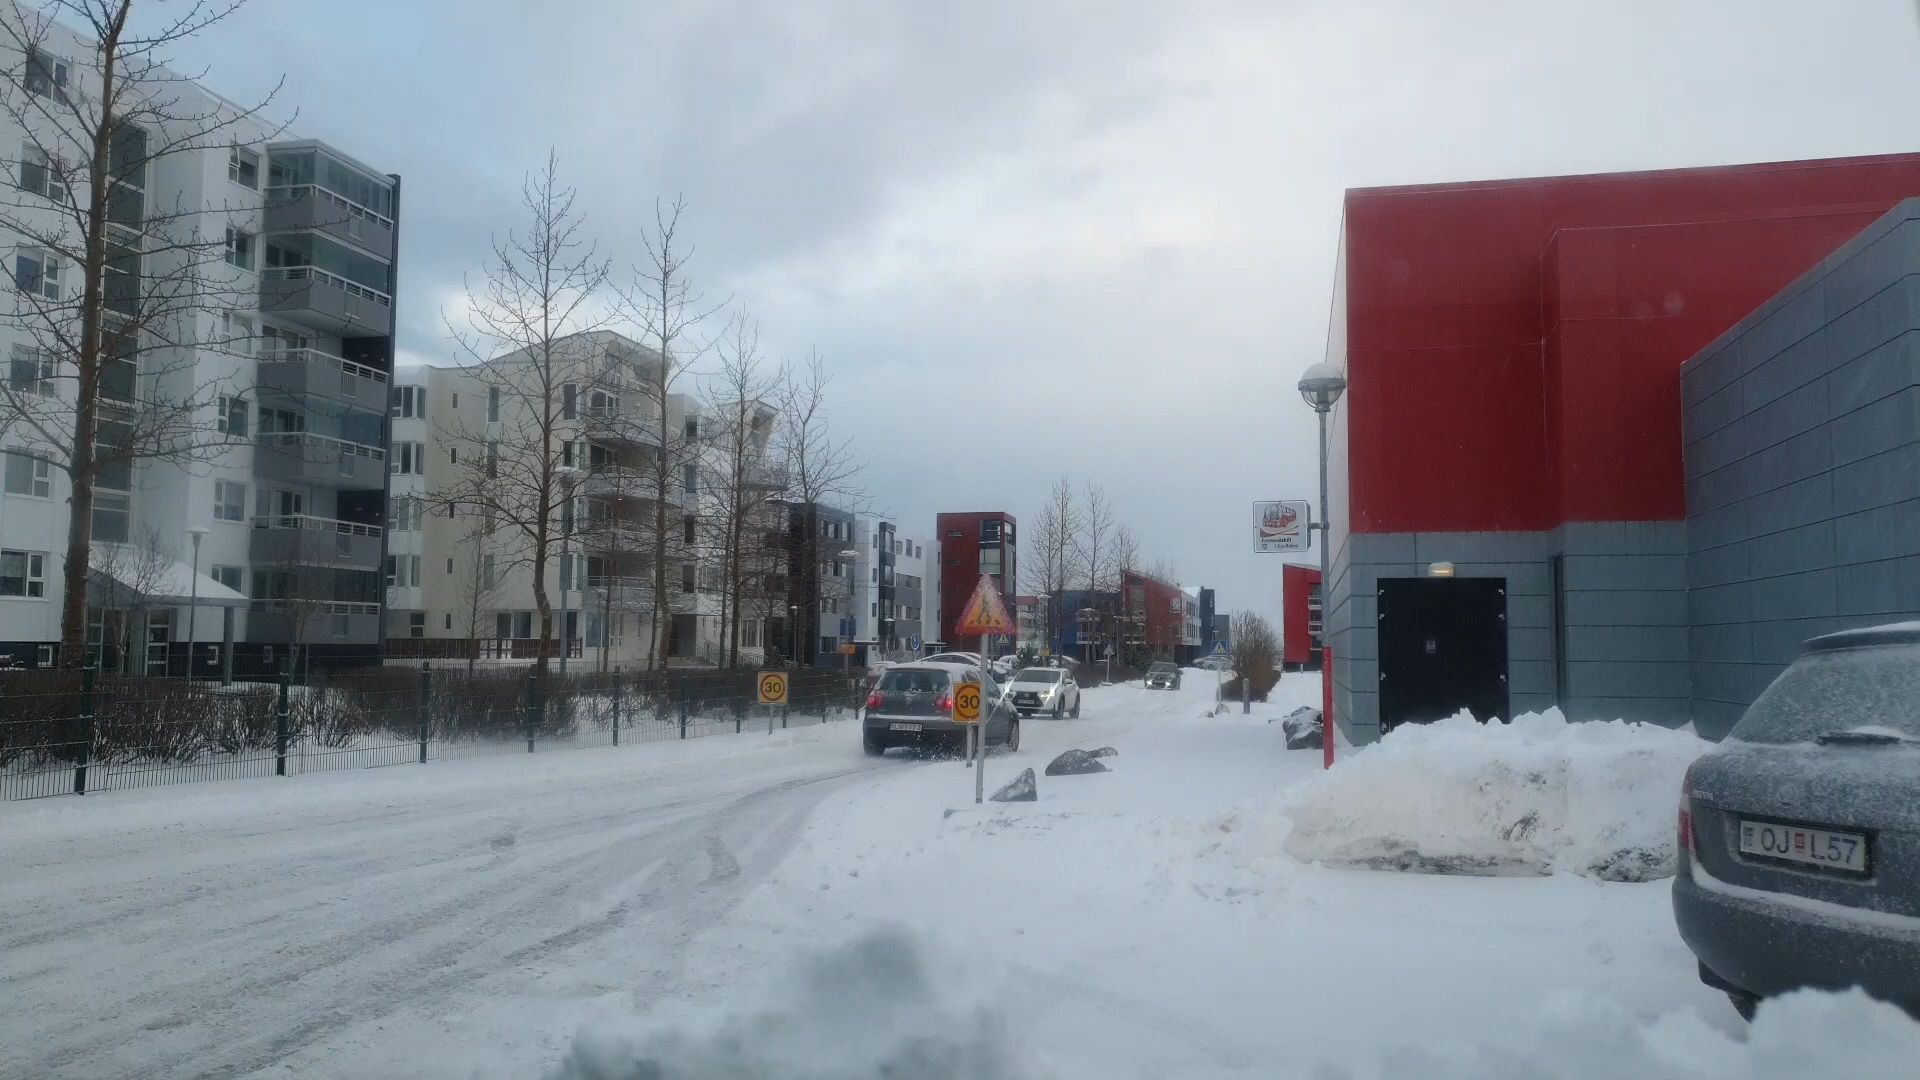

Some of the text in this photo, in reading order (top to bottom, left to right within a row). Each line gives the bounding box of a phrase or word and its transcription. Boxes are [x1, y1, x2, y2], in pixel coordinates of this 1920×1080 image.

[764, 682, 782, 694] 30
[959, 694, 980, 709] 30
[1761, 827, 1789, 854] OJ
[1810, 833, 1858, 864] L57
